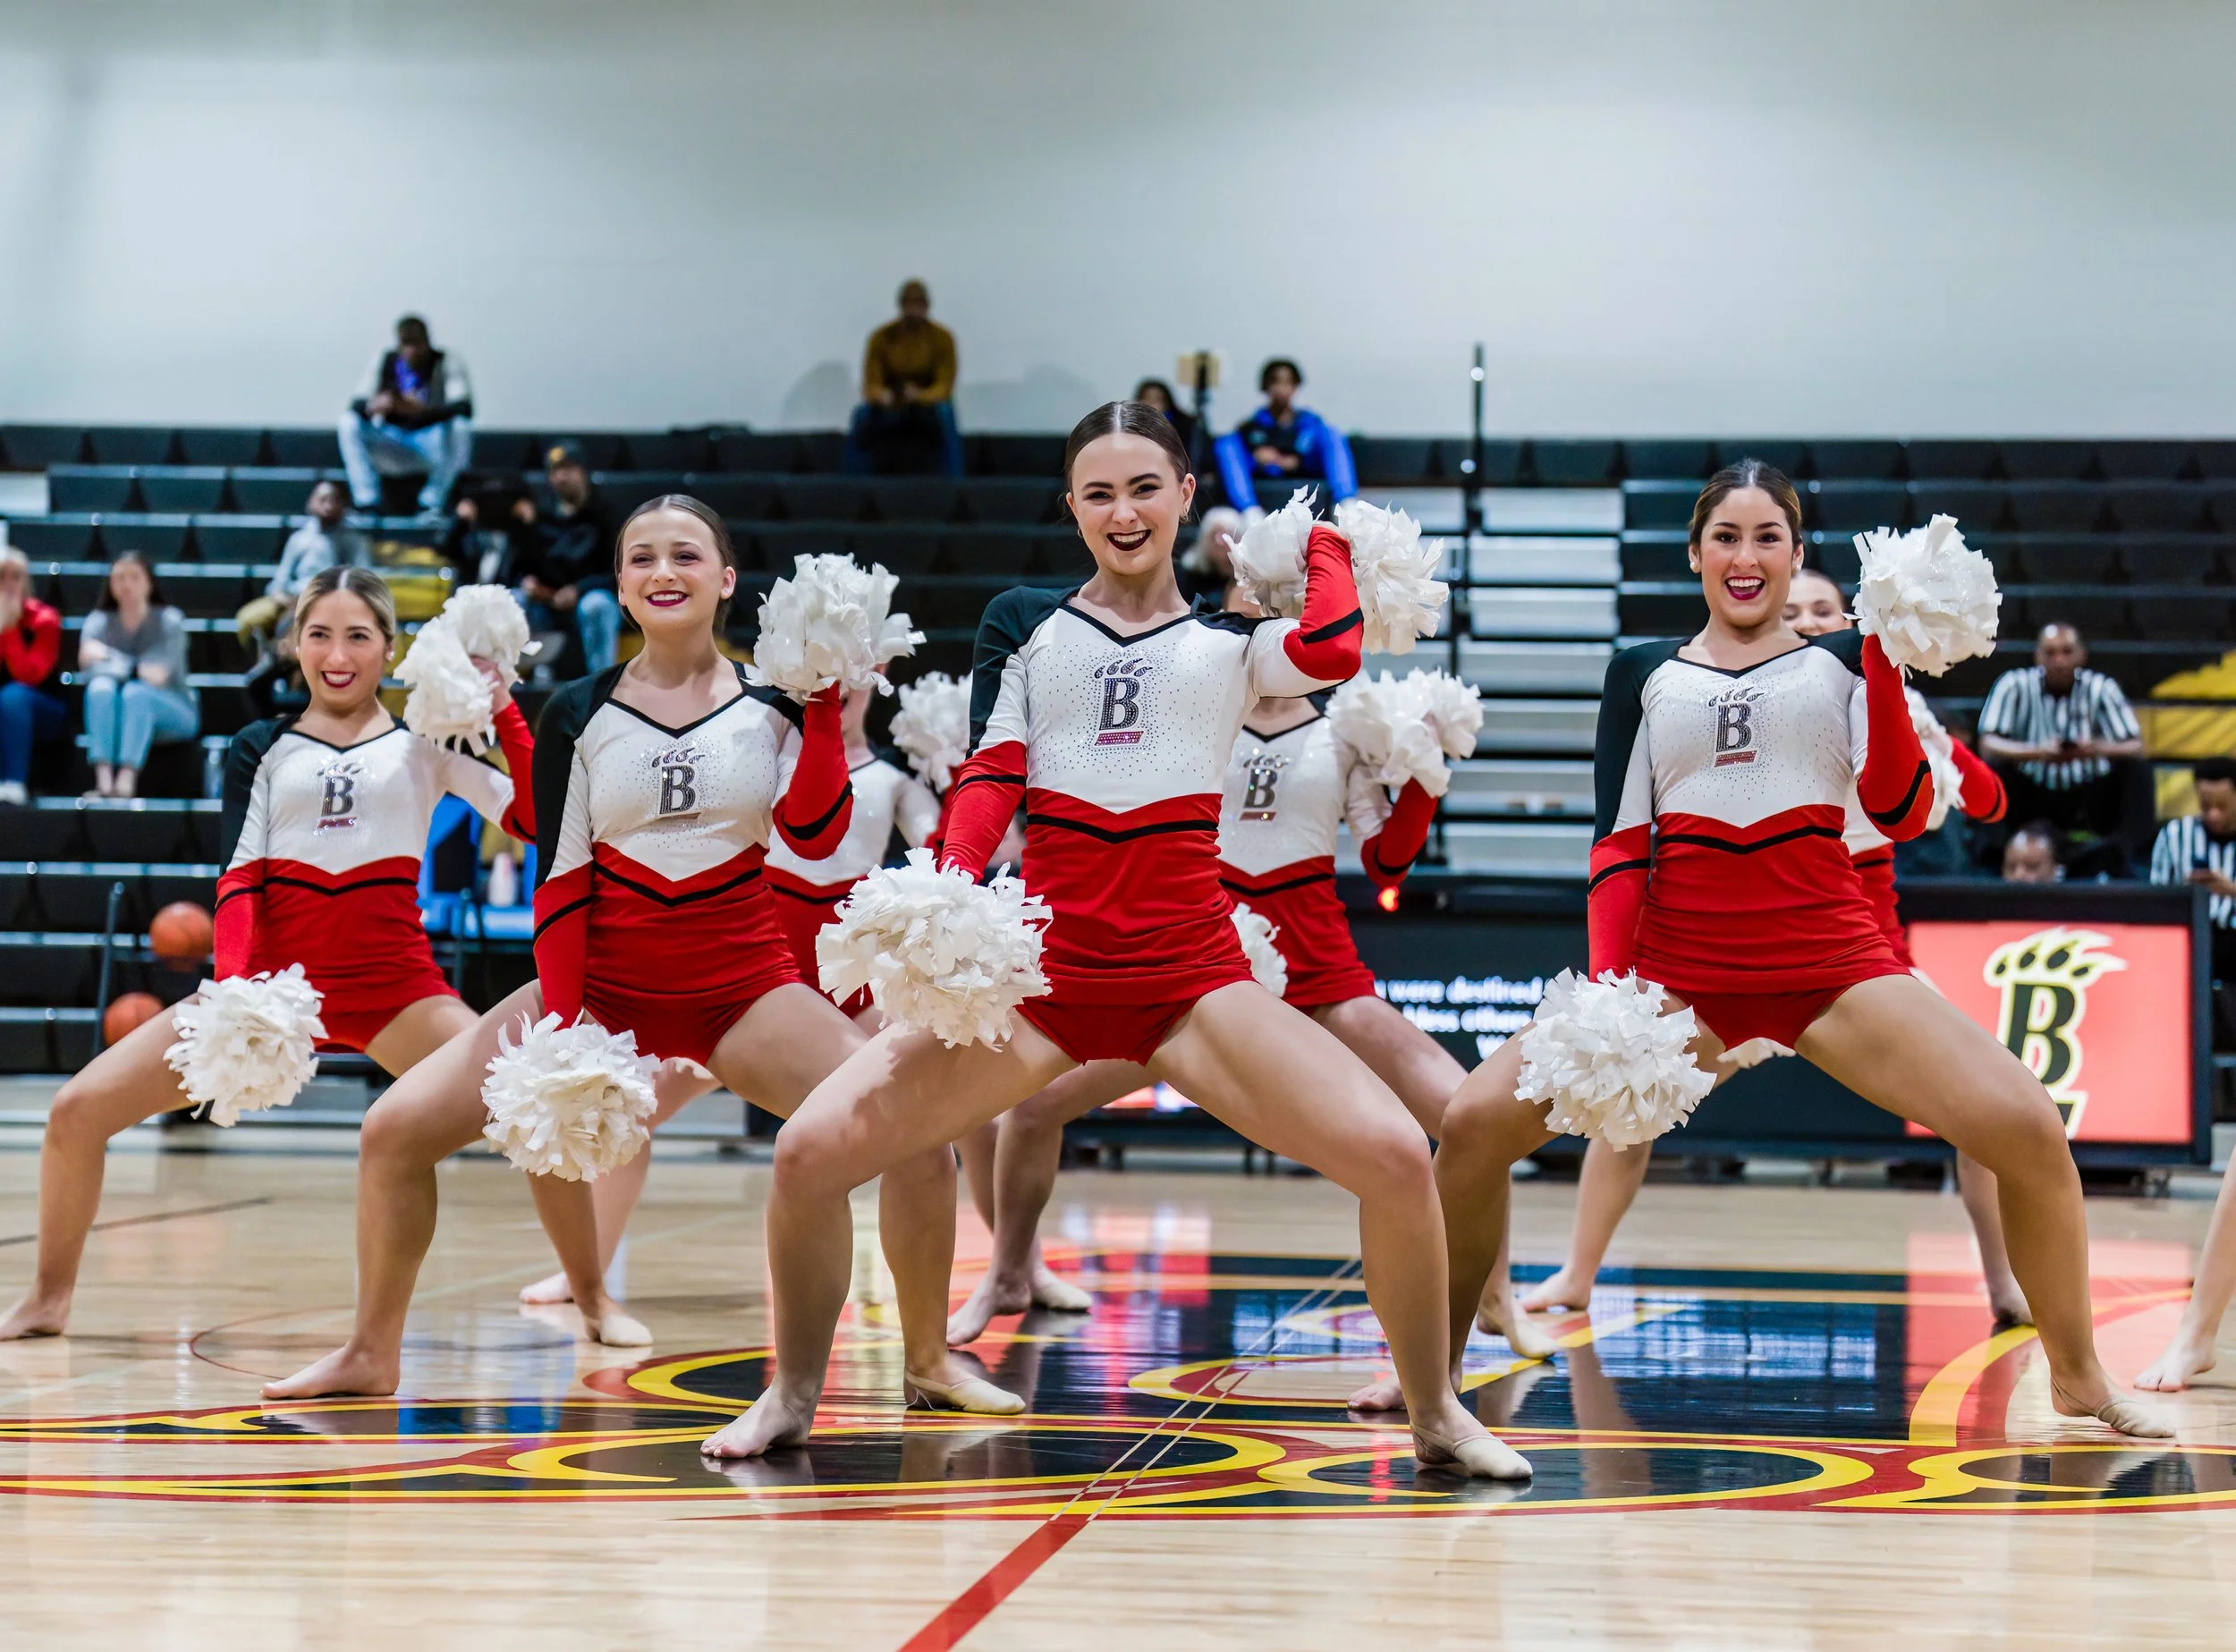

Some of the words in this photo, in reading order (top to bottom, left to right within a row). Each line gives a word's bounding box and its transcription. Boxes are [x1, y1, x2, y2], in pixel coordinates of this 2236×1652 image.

[1098, 677, 1140, 731] B
[1715, 703, 1752, 752] B
[321, 775, 354, 817] B
[659, 765, 696, 814] B
[1242, 769, 1277, 809] B
[2005, 981, 2077, 1088] B
